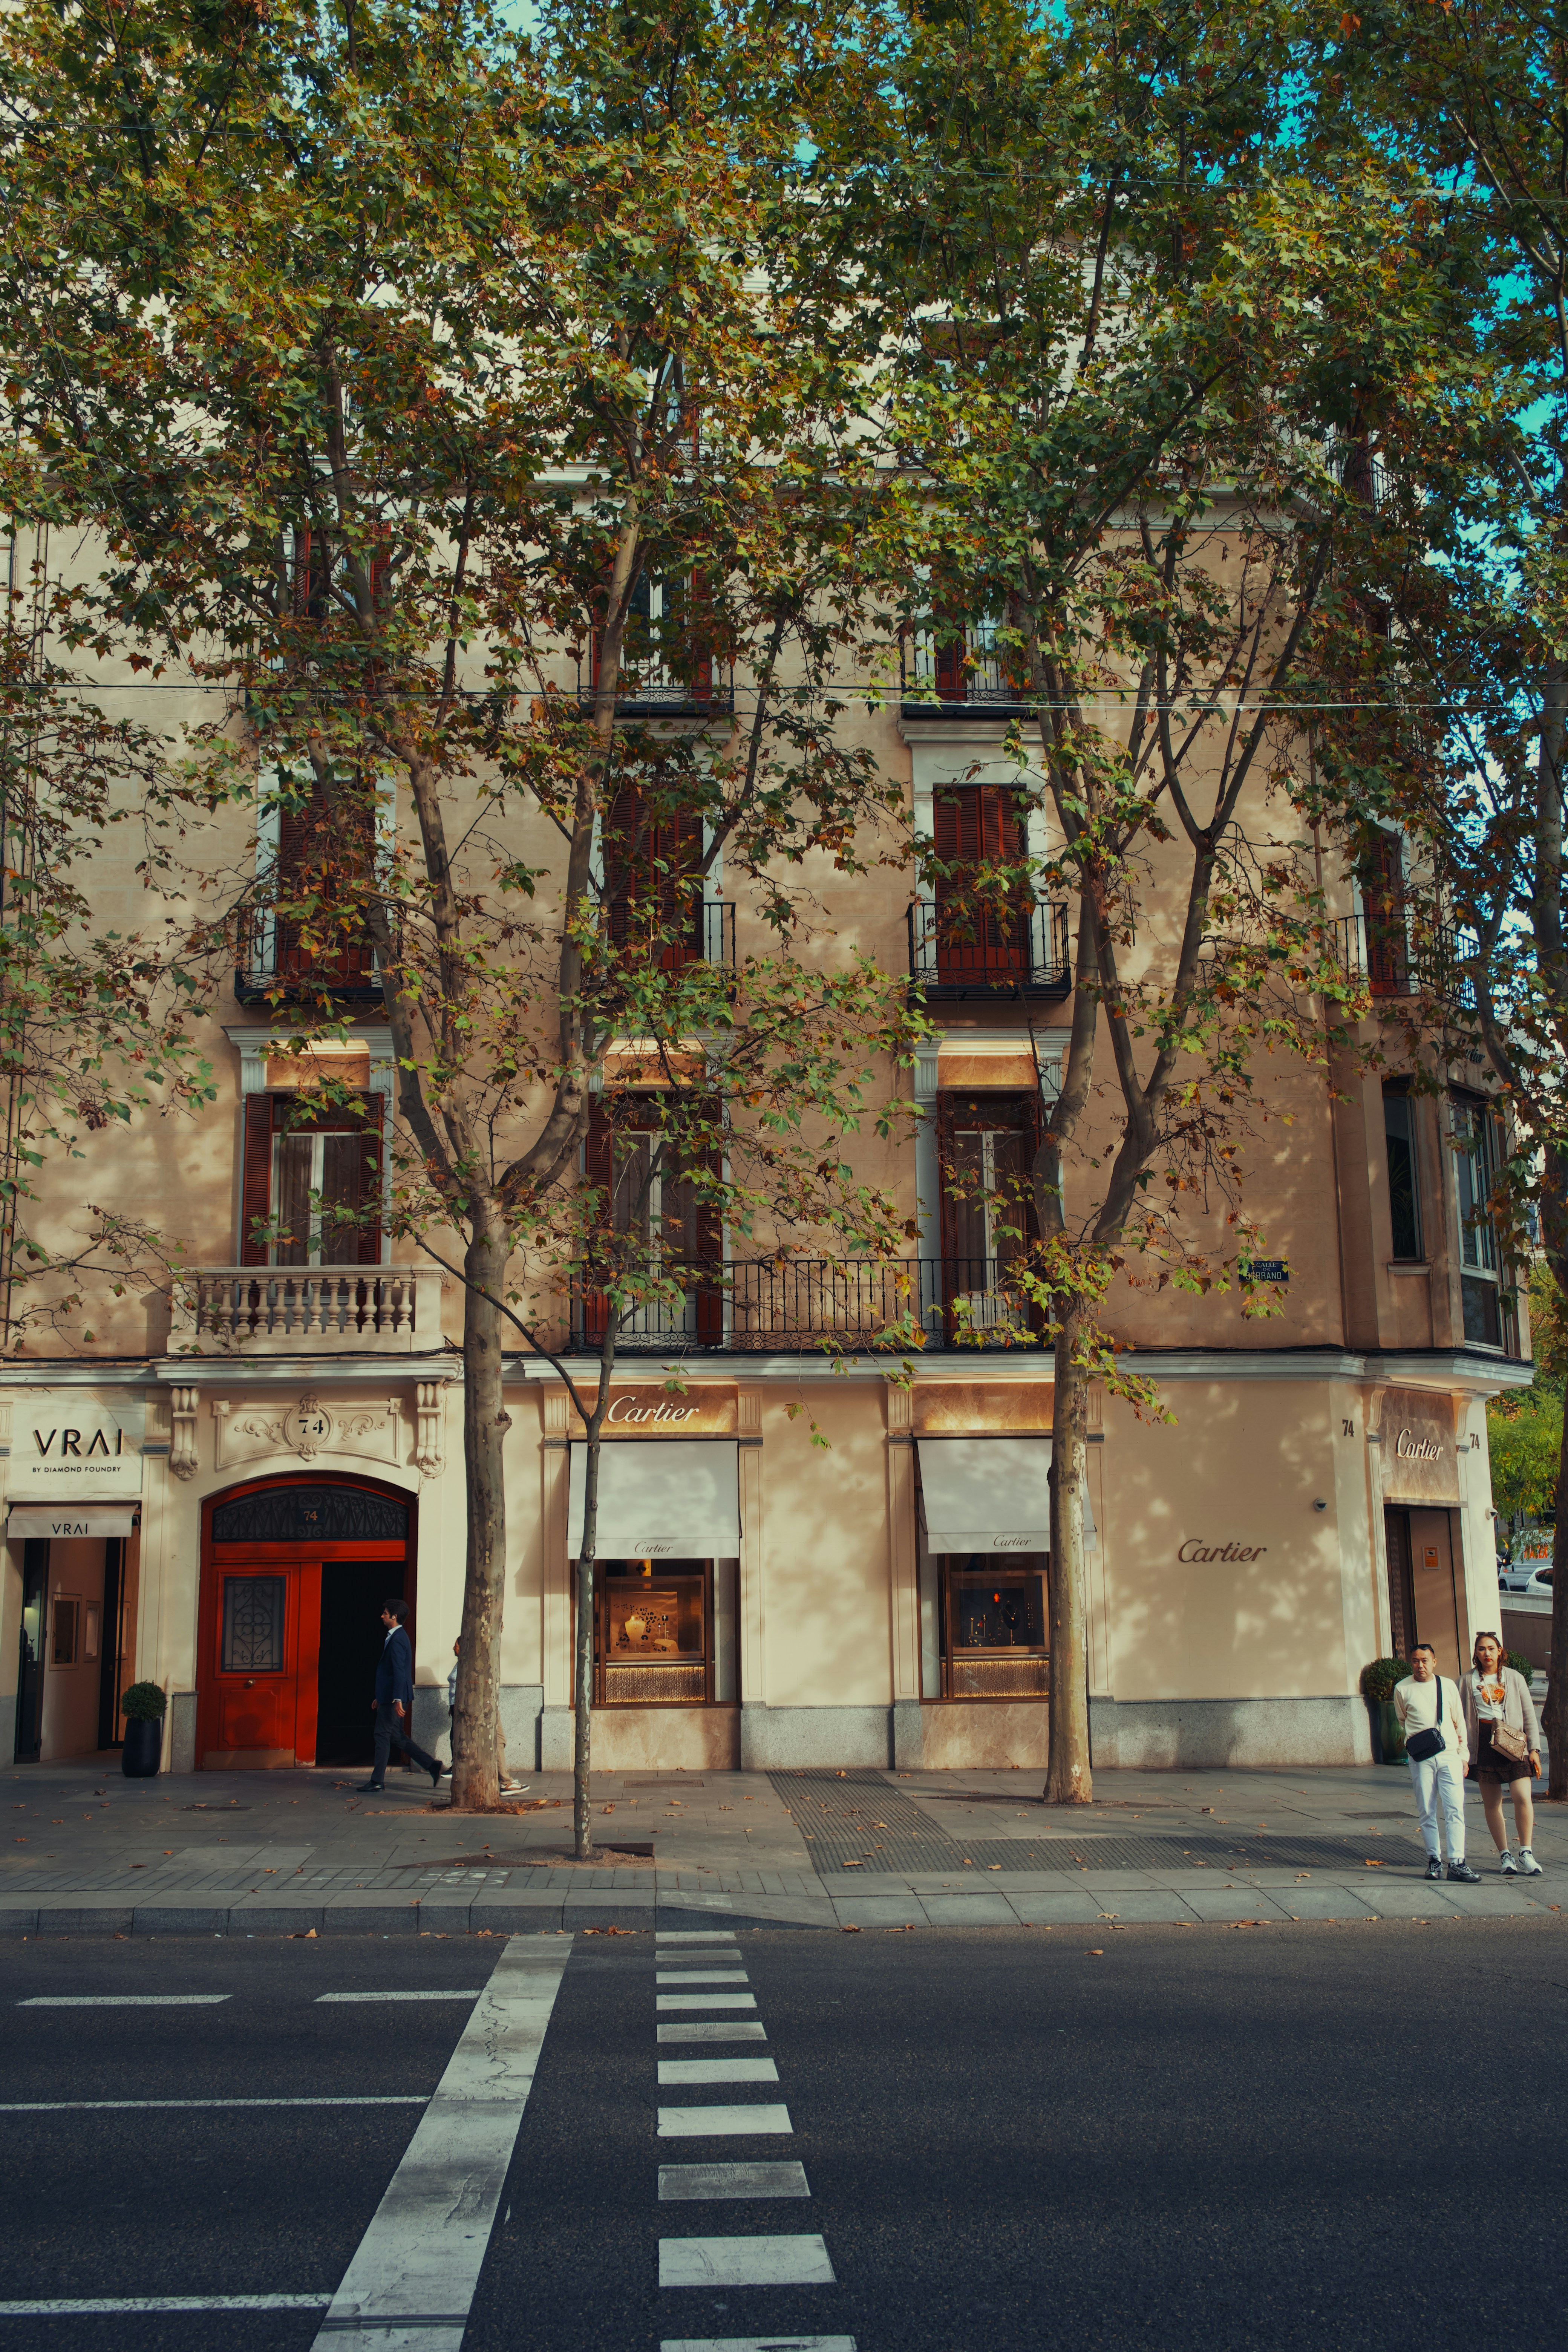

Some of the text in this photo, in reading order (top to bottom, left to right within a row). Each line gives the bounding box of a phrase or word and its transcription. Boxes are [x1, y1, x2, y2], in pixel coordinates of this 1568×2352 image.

[608, 1396, 700, 1422] Cartier
[299, 1419, 323, 1434] 74
[1342, 1419, 1354, 1437] 74
[34, 1428, 123, 1456] VRAI
[1396, 1429, 1444, 1461] Cartier
[1470, 1433, 1480, 1449] 74
[303, 1511, 318, 1521] 74
[52, 1523, 88, 1534] VRAI
[634, 1541, 673, 1553] Cartier
[994, 1534, 1031, 1546] Cartier
[1178, 1539, 1267, 1563] Cartier
